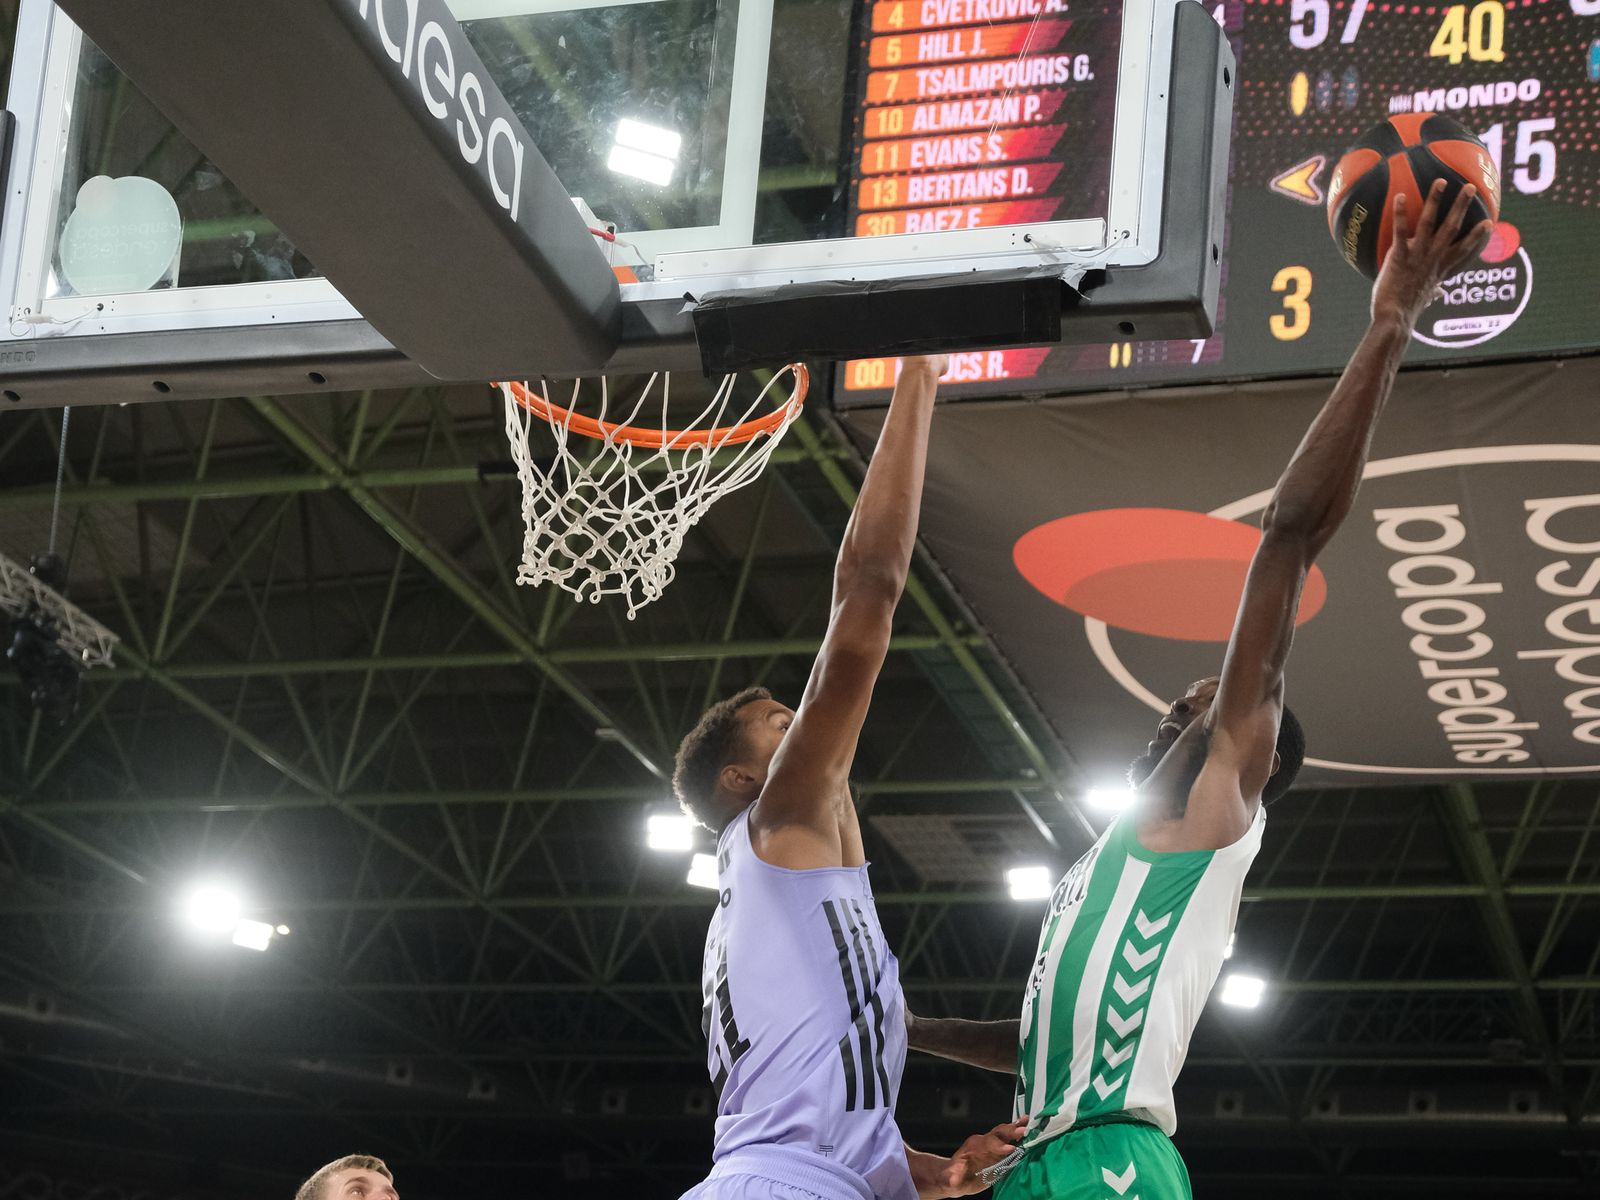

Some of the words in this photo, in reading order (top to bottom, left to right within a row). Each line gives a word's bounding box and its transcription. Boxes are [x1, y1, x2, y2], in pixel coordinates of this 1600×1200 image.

[888, 2, 904, 29] 4
[1429, 1, 1506, 65] 4Q
[886, 38, 902, 64] 5
[917, 32, 967, 61] HILL
[969, 29, 987, 56] J.
[885, 73, 899, 99] 7
[915, 57, 1070, 96] TSALMPOURIS
[1073, 55, 1095, 82] G.
[1412, 78, 1542, 114] MONDO
[359, 0, 524, 223] desa
[877, 108, 904, 134] 10
[911, 97, 1020, 132] ALMAZAN
[1023, 94, 1043, 121] P.
[874, 143, 899, 170] 11
[910, 136, 982, 168] EVANS
[986, 133, 1008, 161] S.
[1478, 117, 1557, 195] 15
[871, 178, 898, 206] 13
[906, 169, 1008, 204] BERTANS
[1011, 167, 1034, 195] D.
[1443, 266, 1517, 287] rcopa
[1443, 283, 1517, 305] desa
[1268, 265, 1313, 341] 3
[854, 359, 885, 387] 00
[987, 350, 1010, 378] R.
[1188, 339, 1206, 365] 7
[1373, 503, 1540, 764] supercopa
[1516, 493, 1600, 745] desa
